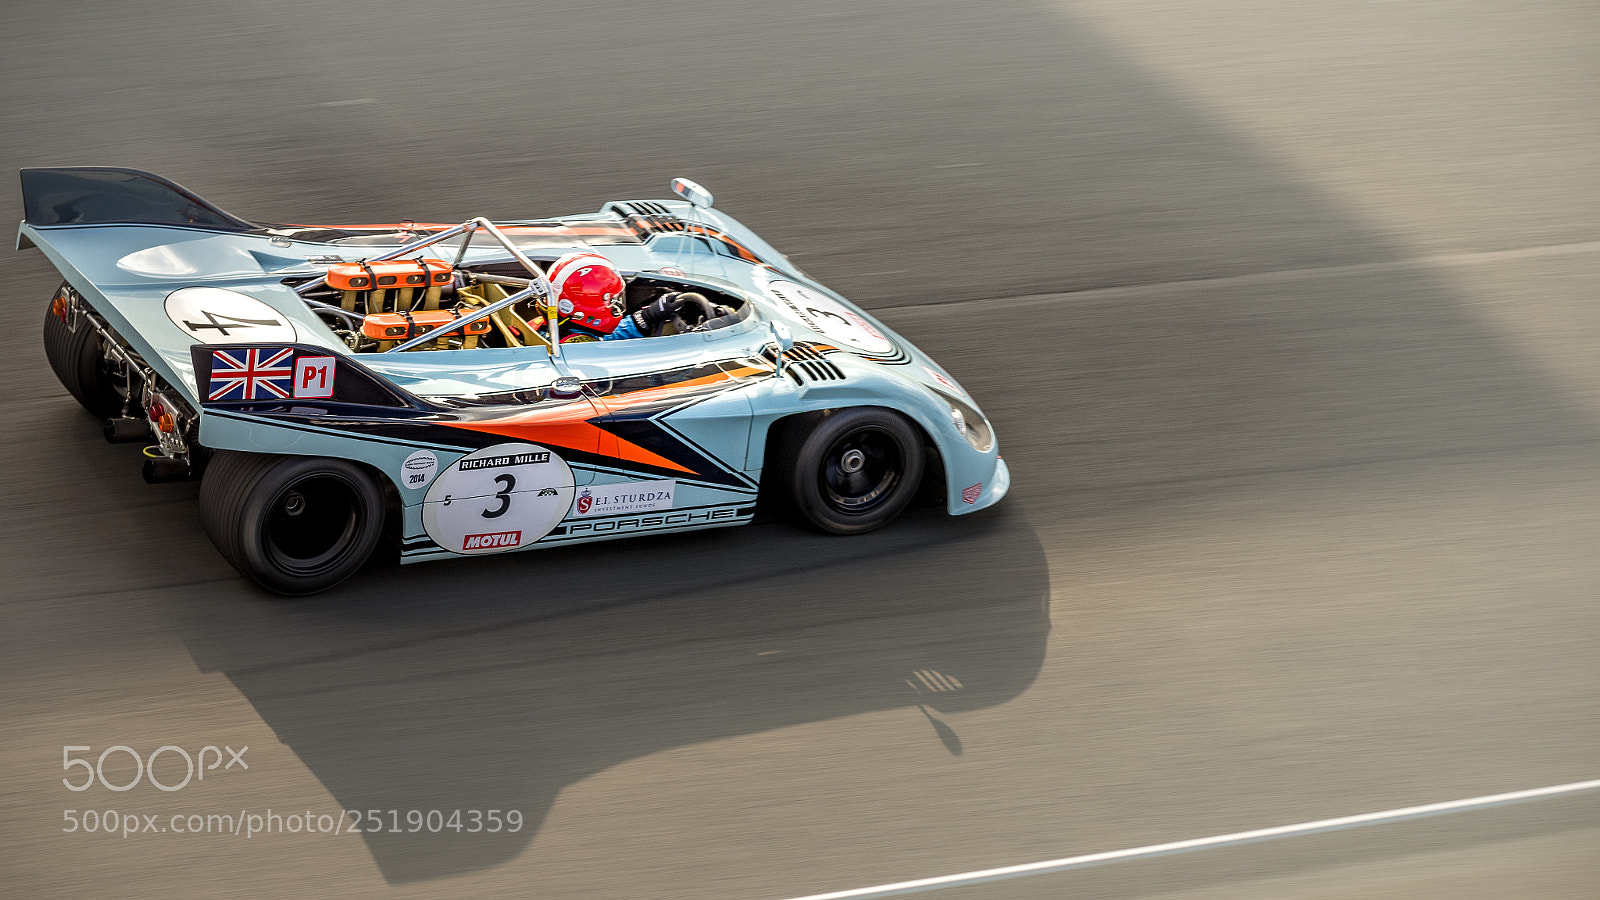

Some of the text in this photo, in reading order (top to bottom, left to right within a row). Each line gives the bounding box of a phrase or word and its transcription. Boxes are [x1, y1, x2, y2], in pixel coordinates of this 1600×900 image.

[182, 309, 282, 336] 4
[806, 307, 852, 326] 3
[302, 365, 328, 389] P1
[461, 453, 549, 470] RICHARD MILLE
[409, 473, 426, 484] 2014
[443, 495, 452, 506] 5
[481, 473, 516, 519] 3
[595, 491, 671, 506] E.I. STURDZA
[569, 508, 735, 535] PORSCHE
[465, 532, 519, 549] MOTUL
